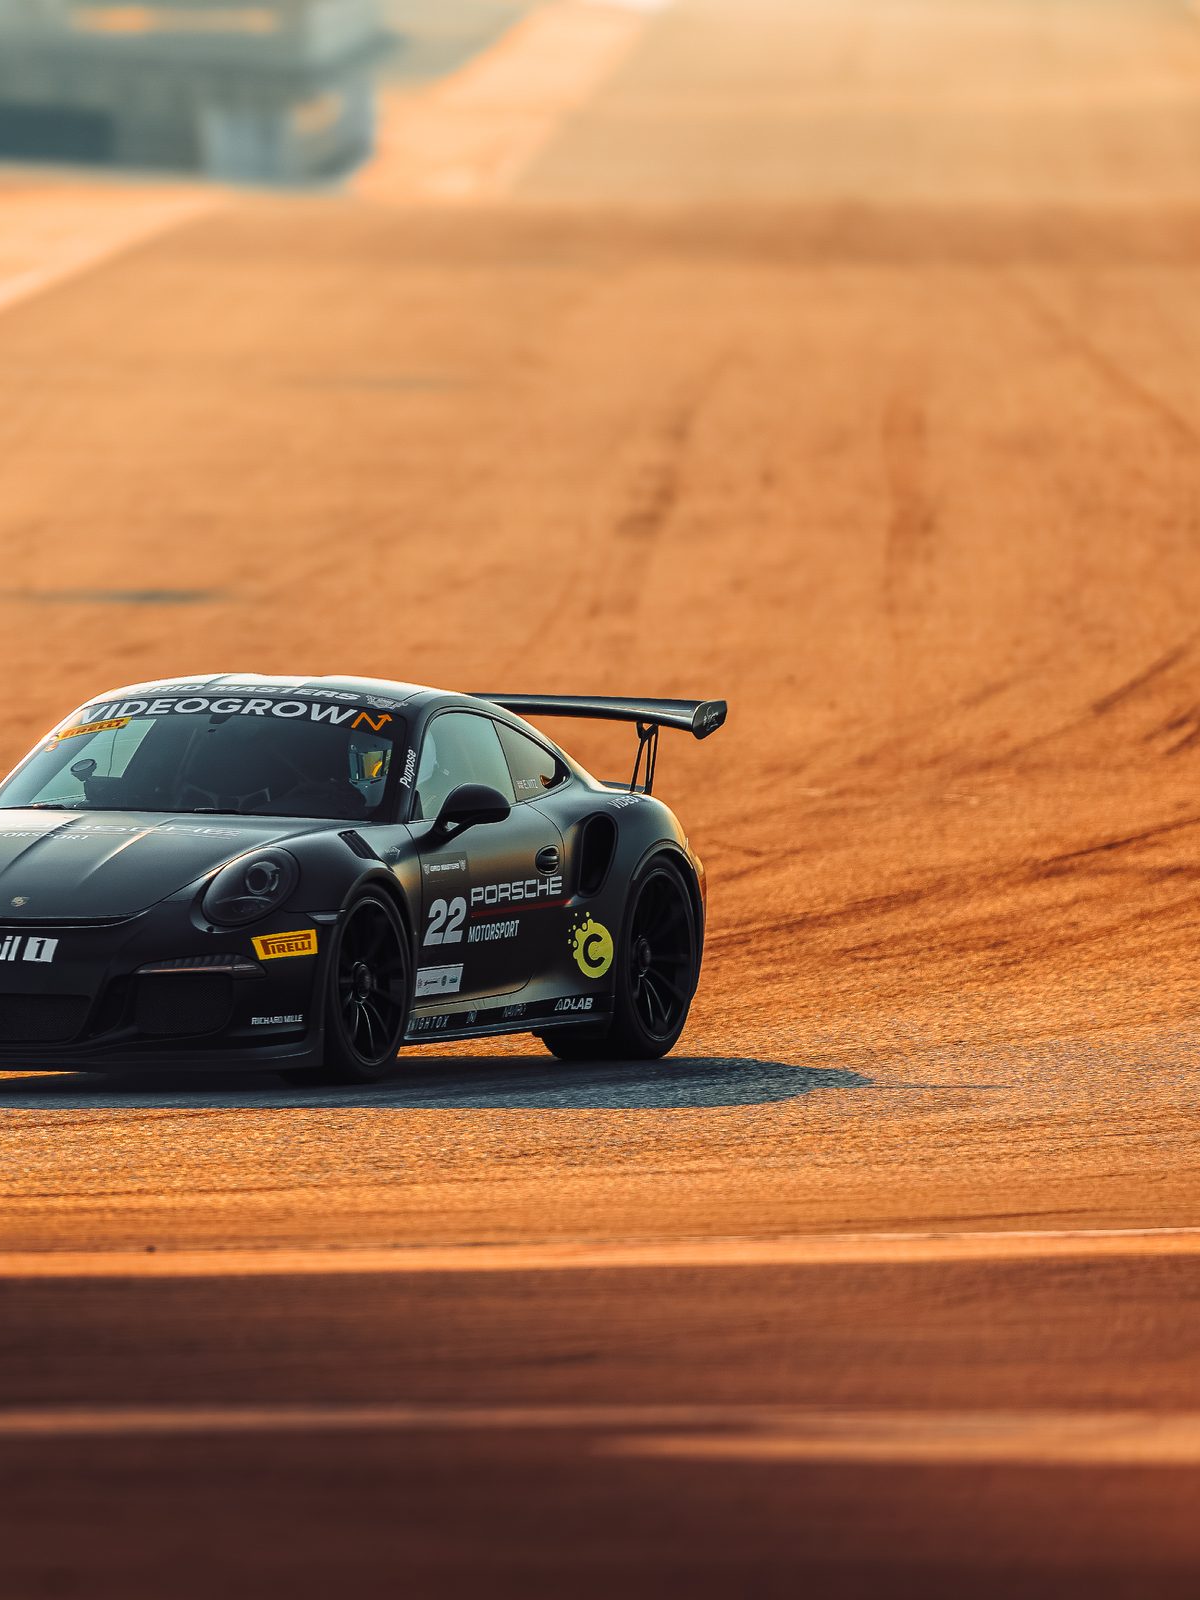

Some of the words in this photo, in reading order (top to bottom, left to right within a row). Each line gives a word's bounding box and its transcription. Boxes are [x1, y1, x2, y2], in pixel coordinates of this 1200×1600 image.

[209, 685, 360, 702] MASTERS
[399, 748, 417, 789] Purpose
[471, 875, 563, 906] PORSCHE
[422, 896, 467, 947] 22
[468, 919, 520, 944] MOTORSPORT
[261, 933, 312, 956] PIRELLI
